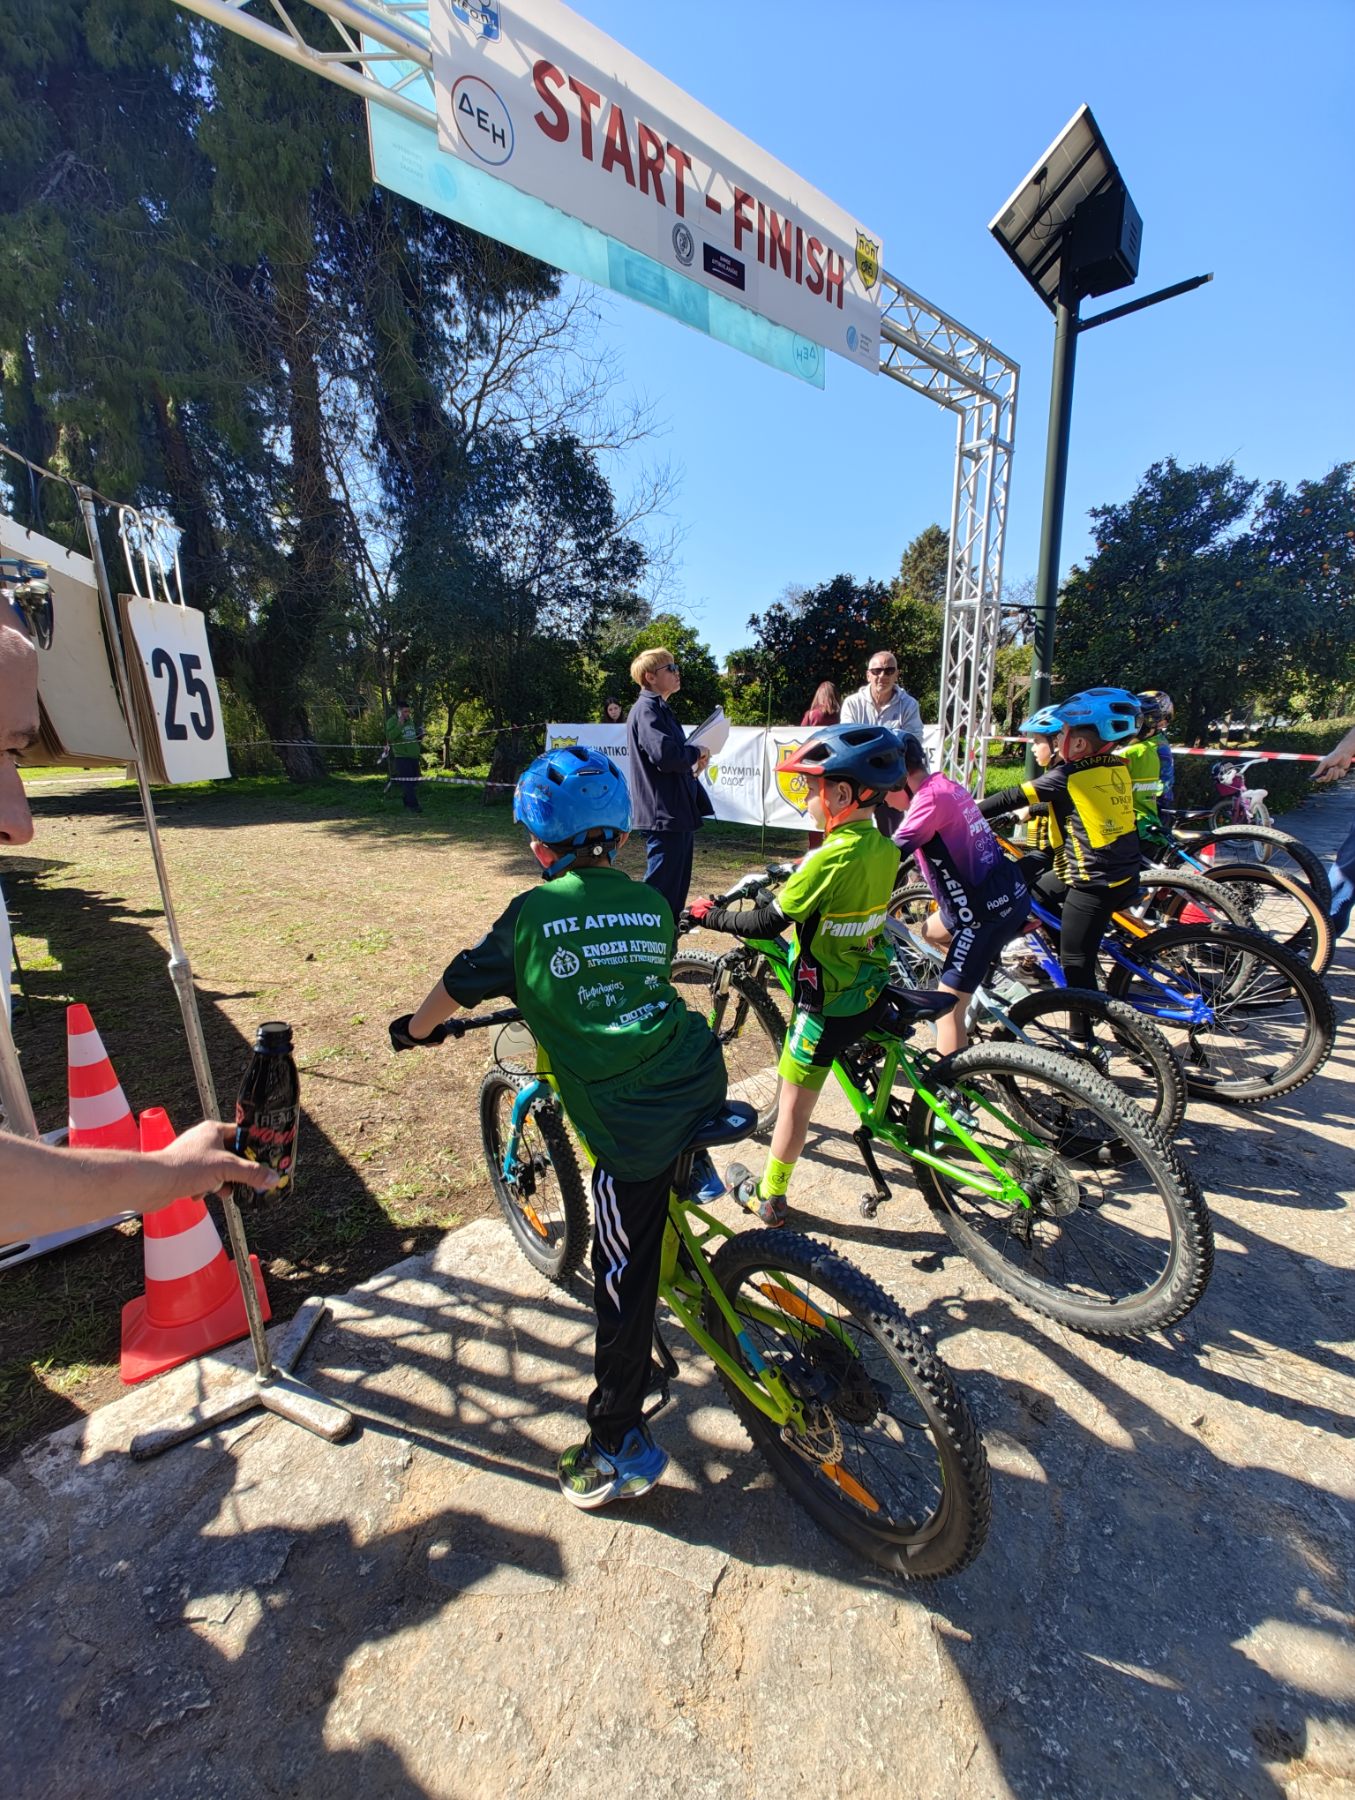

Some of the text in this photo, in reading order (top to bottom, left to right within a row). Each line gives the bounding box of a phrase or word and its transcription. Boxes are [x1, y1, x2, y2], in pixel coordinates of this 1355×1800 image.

[458, 92, 506, 149] ΔΕΗ
[532, 59, 692, 218] START
[734, 186, 845, 310] FINISH
[151, 648, 214, 740] 25
[721, 765, 761, 777] ΟΛΥΜΠΙΑ
[721, 777, 745, 787] ΟΔΟΣ
[543, 913, 661, 938] ΓΠΣ ΑΓΡΙΝΙΟΥ
[582, 940, 667, 957] ΕΝΩΣΗ ΑΓΡΙΝΙΟΥ
